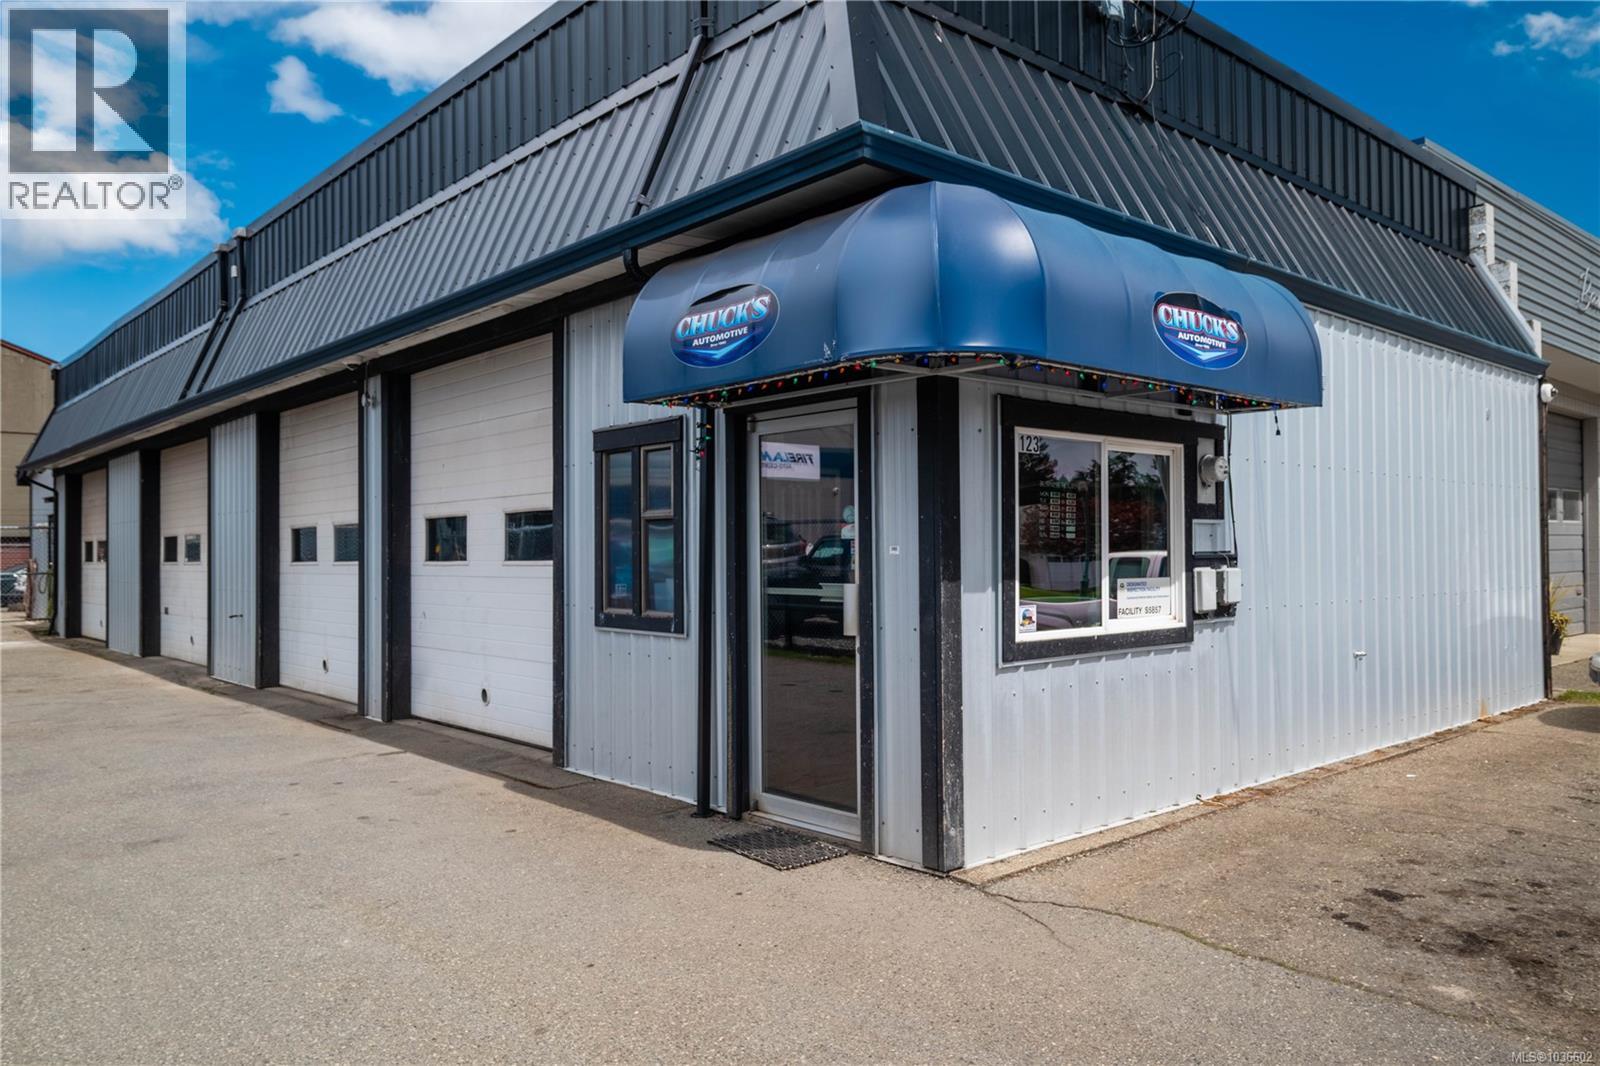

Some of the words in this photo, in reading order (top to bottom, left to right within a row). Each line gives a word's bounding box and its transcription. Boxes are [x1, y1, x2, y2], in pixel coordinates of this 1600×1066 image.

[675, 295, 769, 339] CHUCK'S
[1158, 304, 1239, 341] CHUCK'S
[692, 326, 748, 347] AUTOMOTIVE
[1178, 331, 1227, 349] AUTOMOTIVE
[1020, 435, 1040, 453] 123
[1118, 607, 1142, 616] FACILITY
